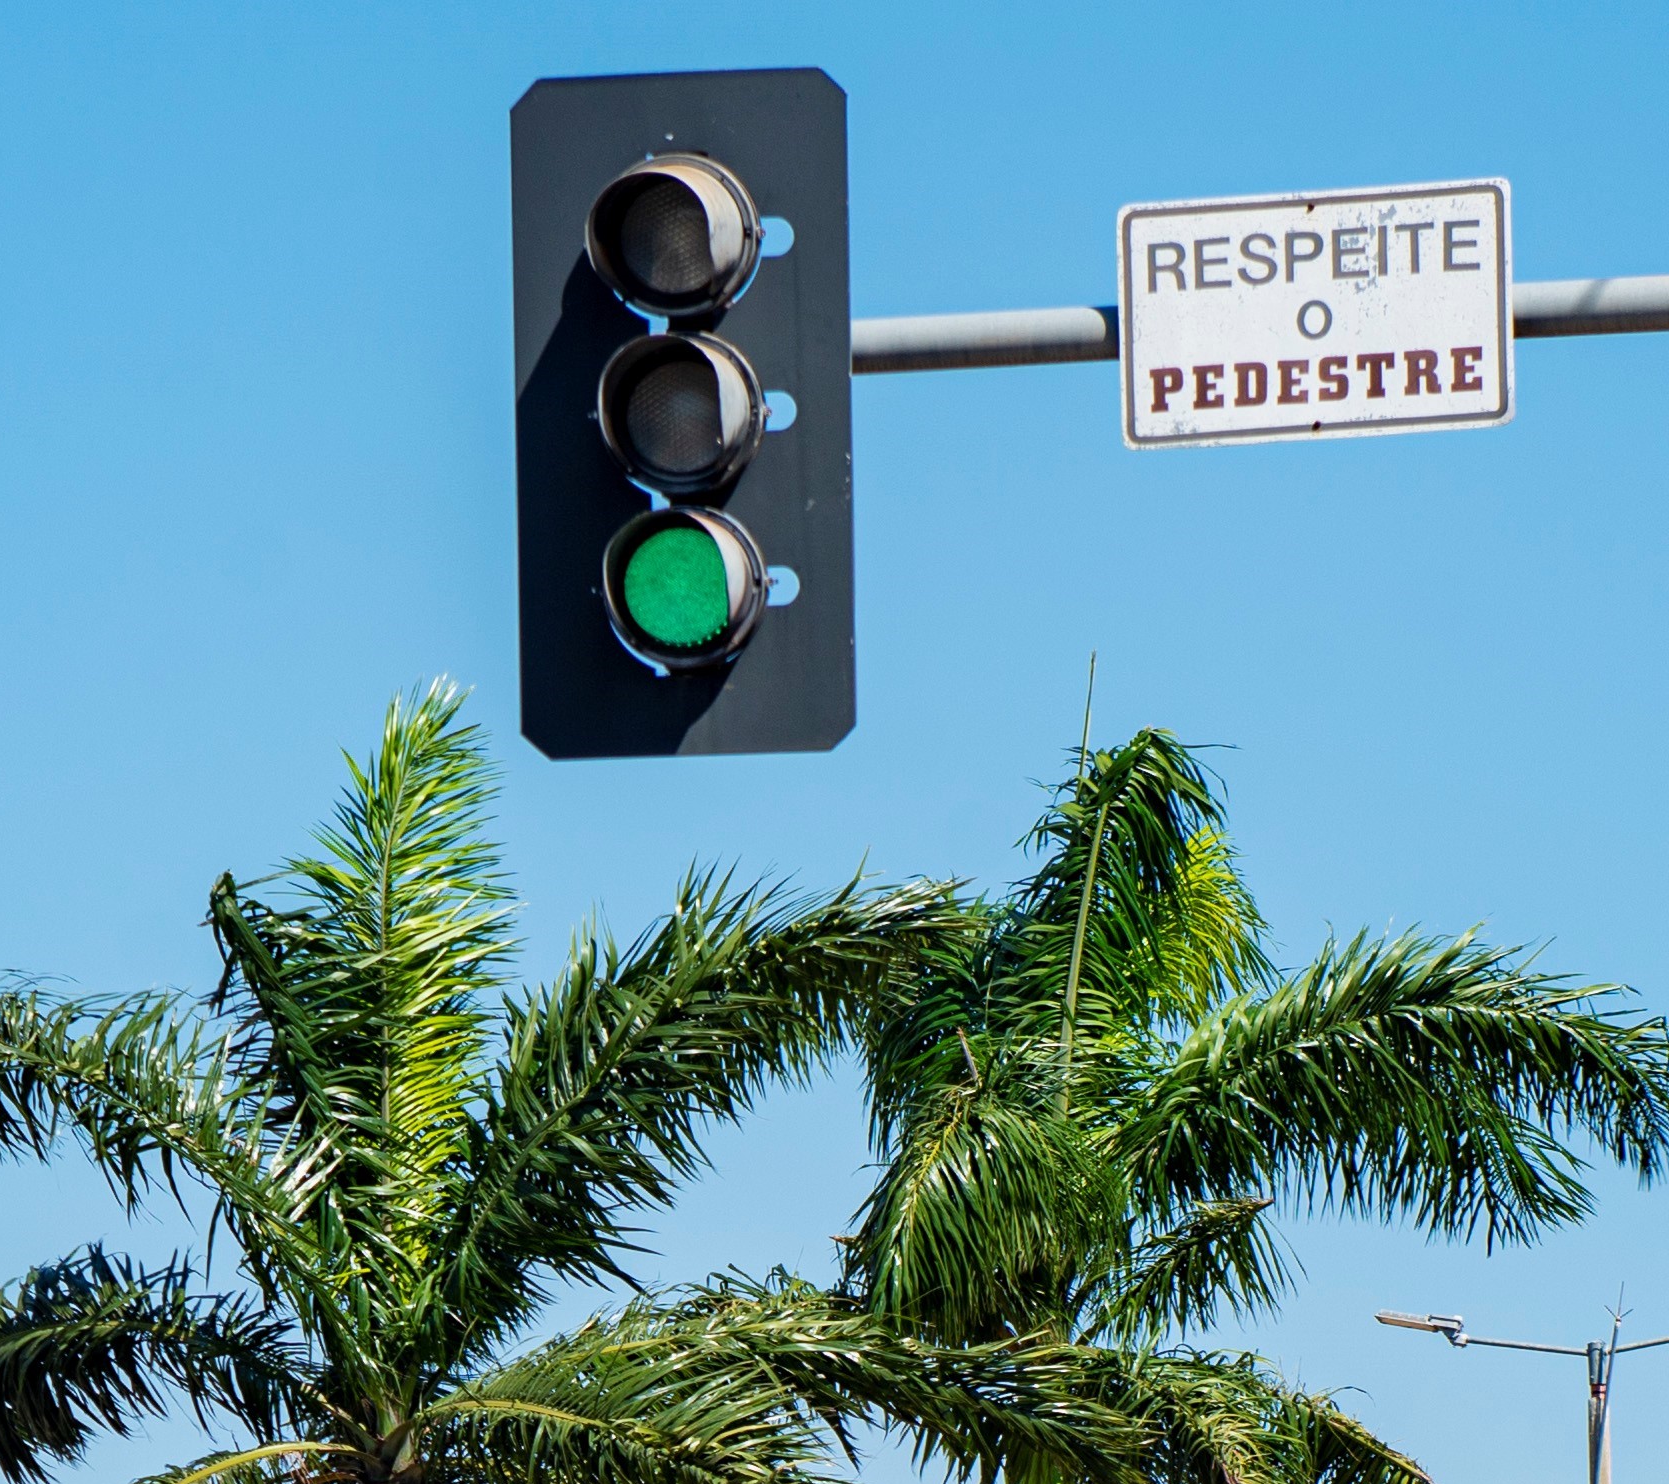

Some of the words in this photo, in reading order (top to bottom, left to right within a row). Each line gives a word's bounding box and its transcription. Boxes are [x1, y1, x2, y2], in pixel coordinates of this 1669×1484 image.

[1147, 219, 1481, 294] RESPEITE
[1296, 300, 1333, 340] O
[1149, 346, 1483, 413] PEDESTRE
